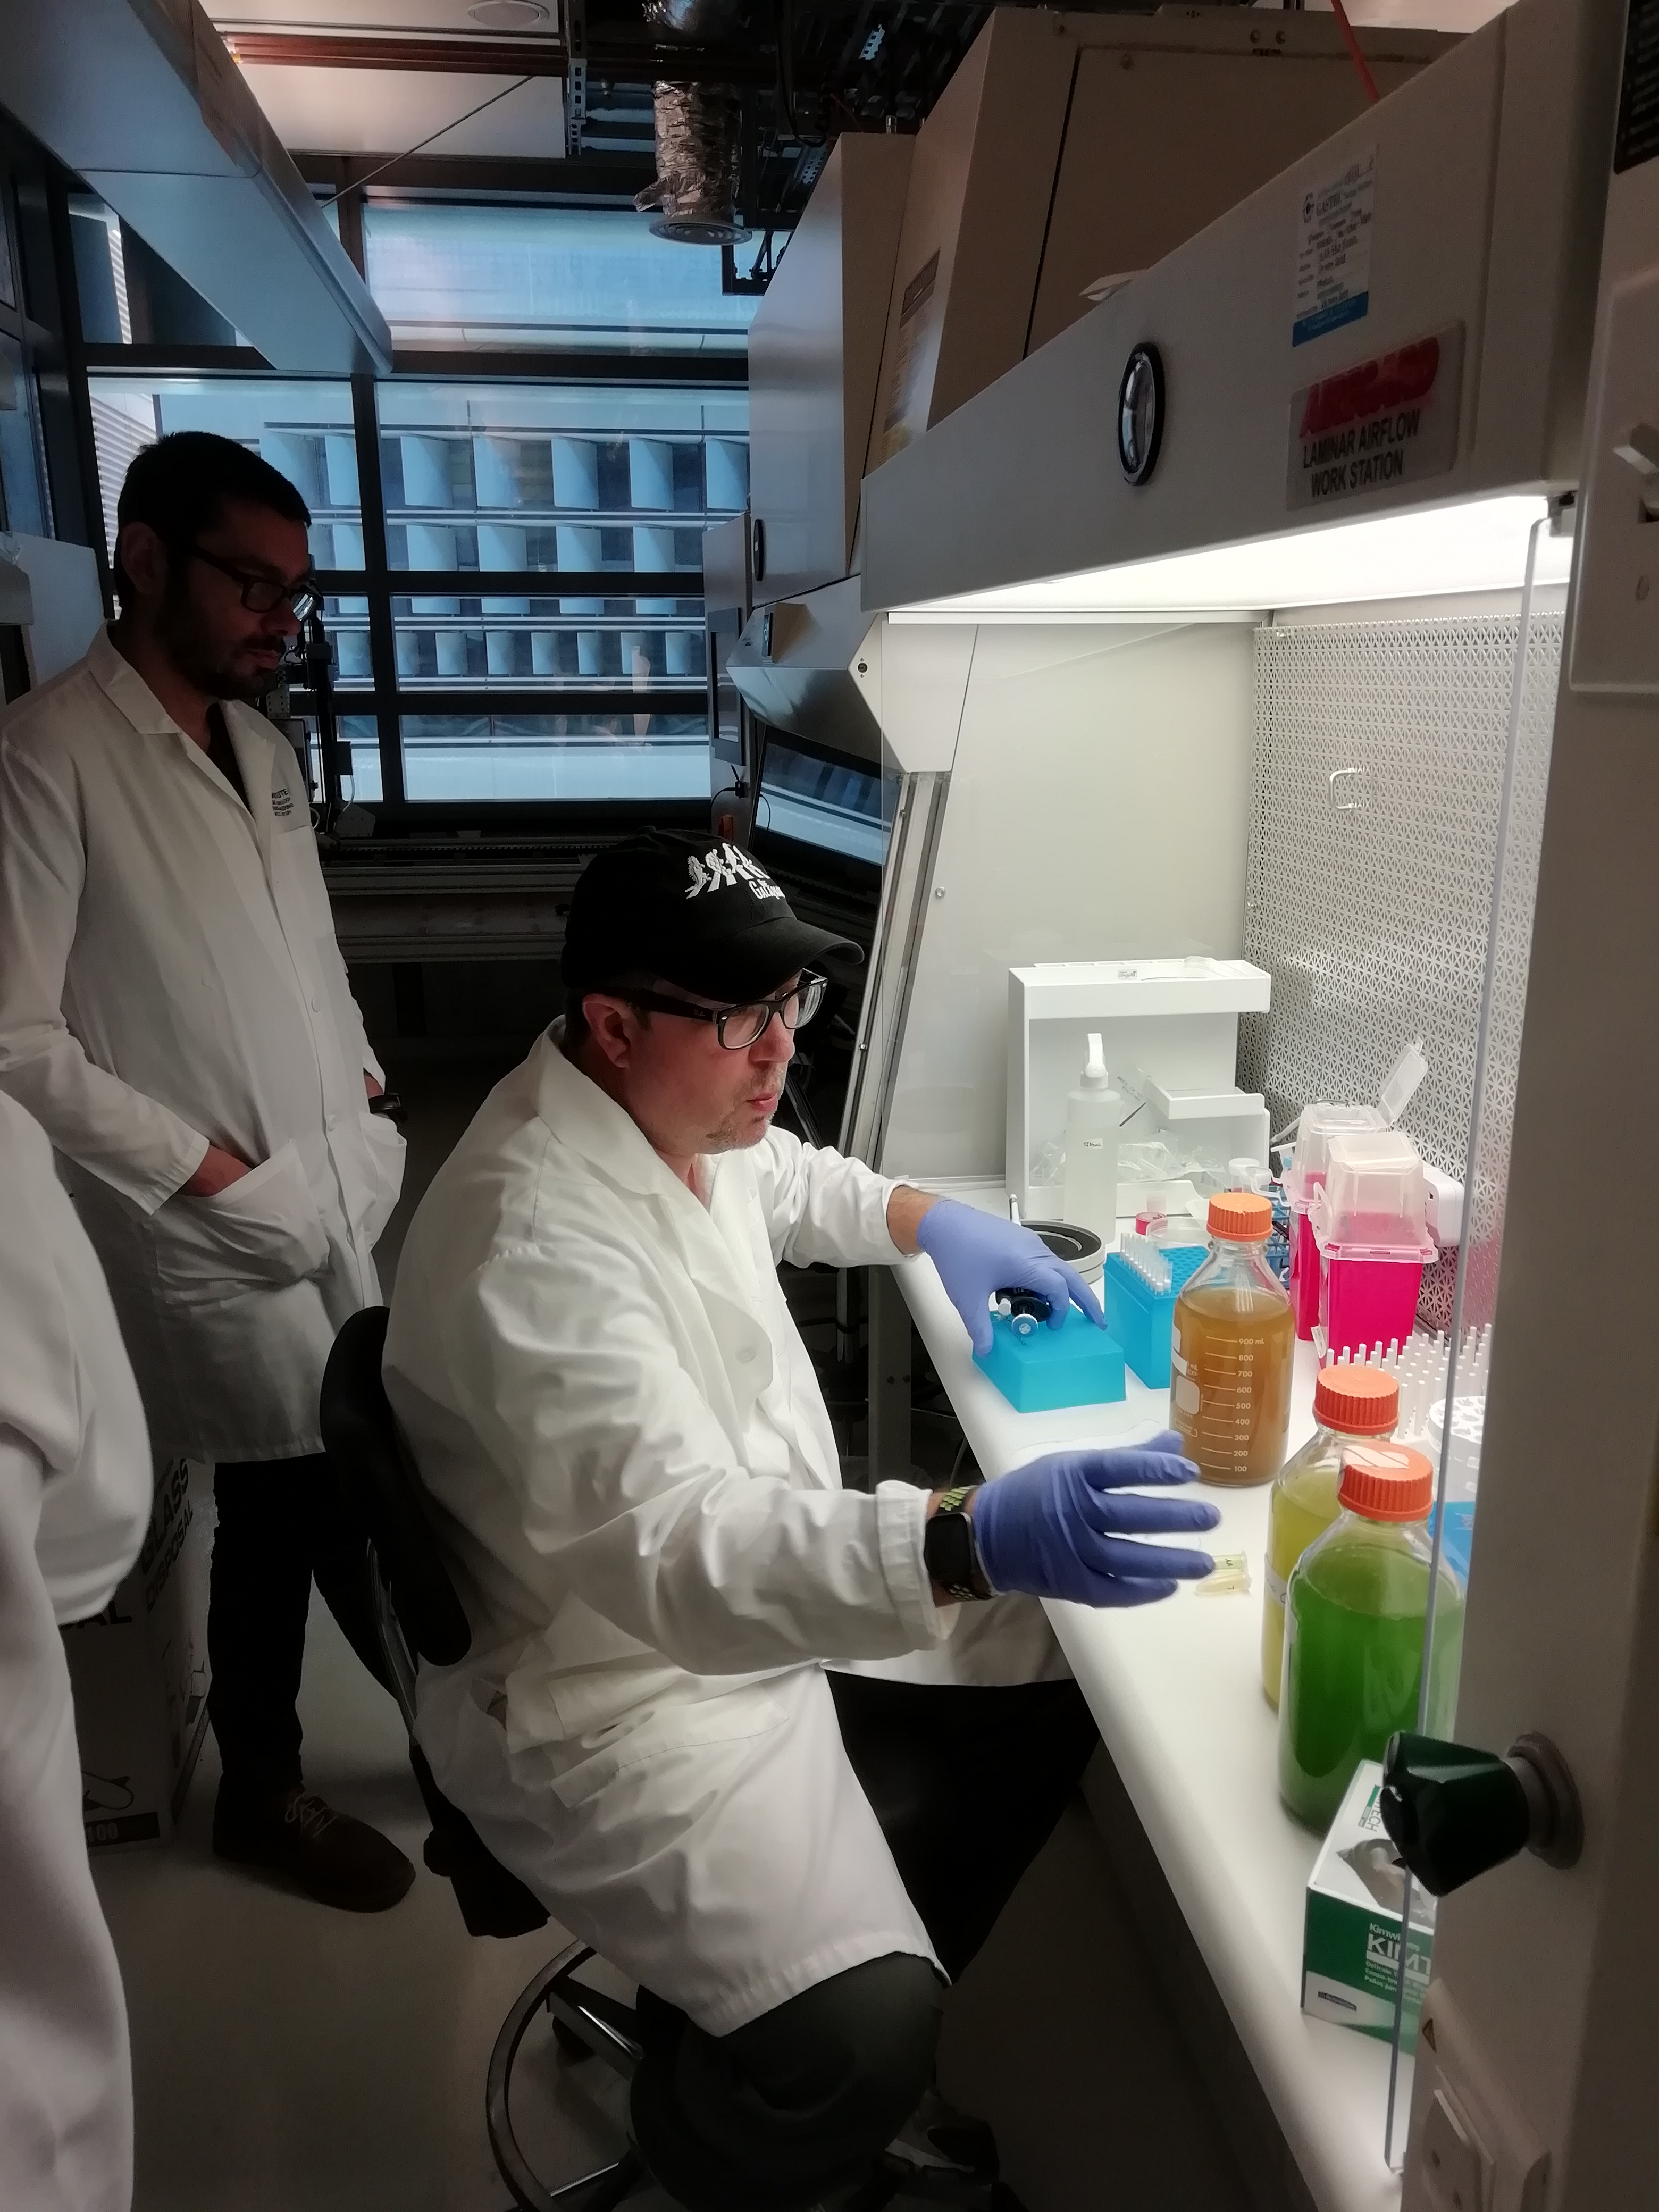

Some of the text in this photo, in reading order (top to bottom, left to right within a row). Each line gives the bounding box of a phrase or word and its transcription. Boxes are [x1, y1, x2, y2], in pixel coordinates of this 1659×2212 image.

[1303, 409, 1421, 470] LAMINAR AIRFLOW
[1311, 450, 1404, 498] WORK STATION
[140, 1457, 189, 1575] GLASS
[146, 1500, 194, 1614] DISPOSAL
